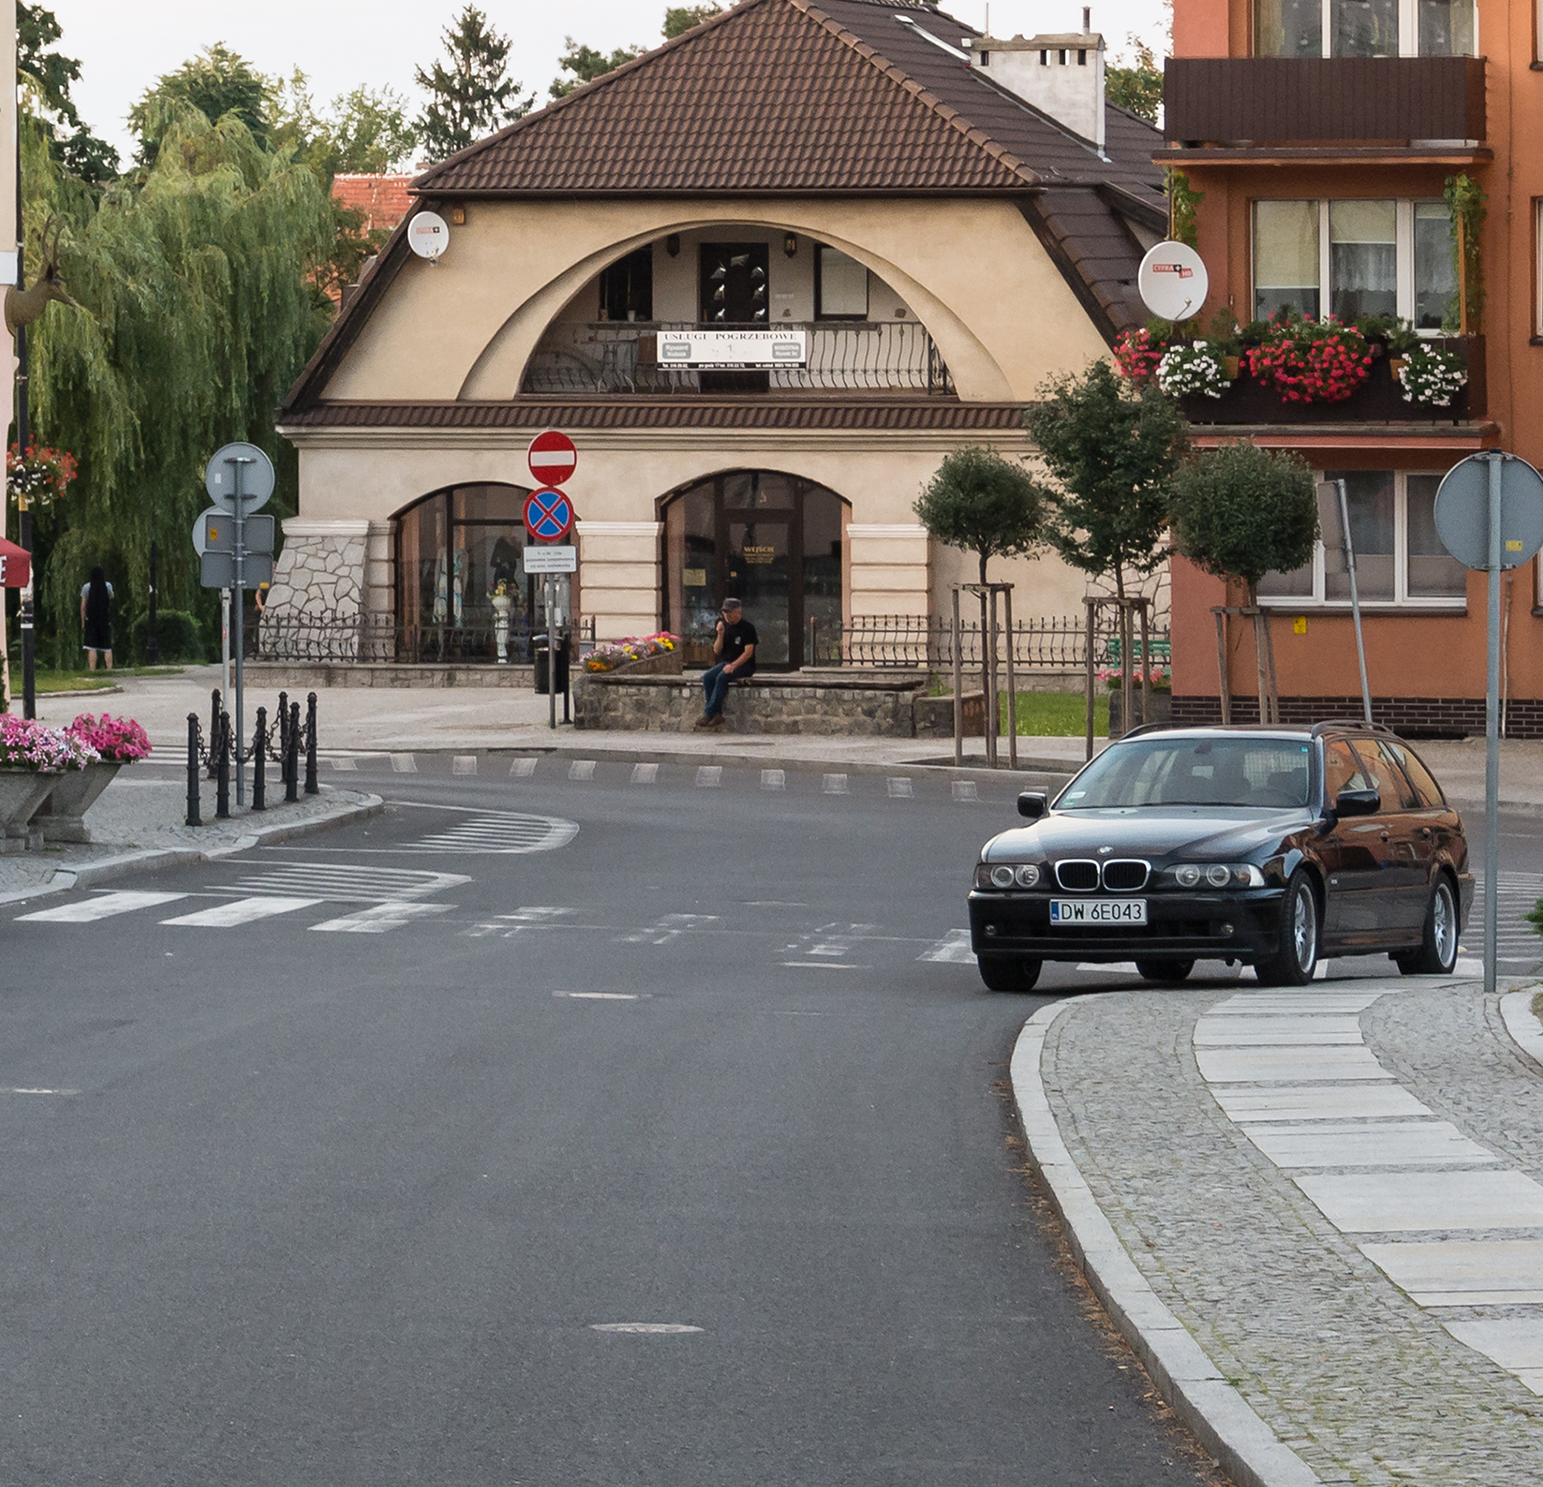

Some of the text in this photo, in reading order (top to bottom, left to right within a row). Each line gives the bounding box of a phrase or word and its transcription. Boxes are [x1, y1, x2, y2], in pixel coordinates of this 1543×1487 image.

[715, 333, 797, 341] POGRZEBOWE
[1061, 903, 1142, 920] DW 6E043
